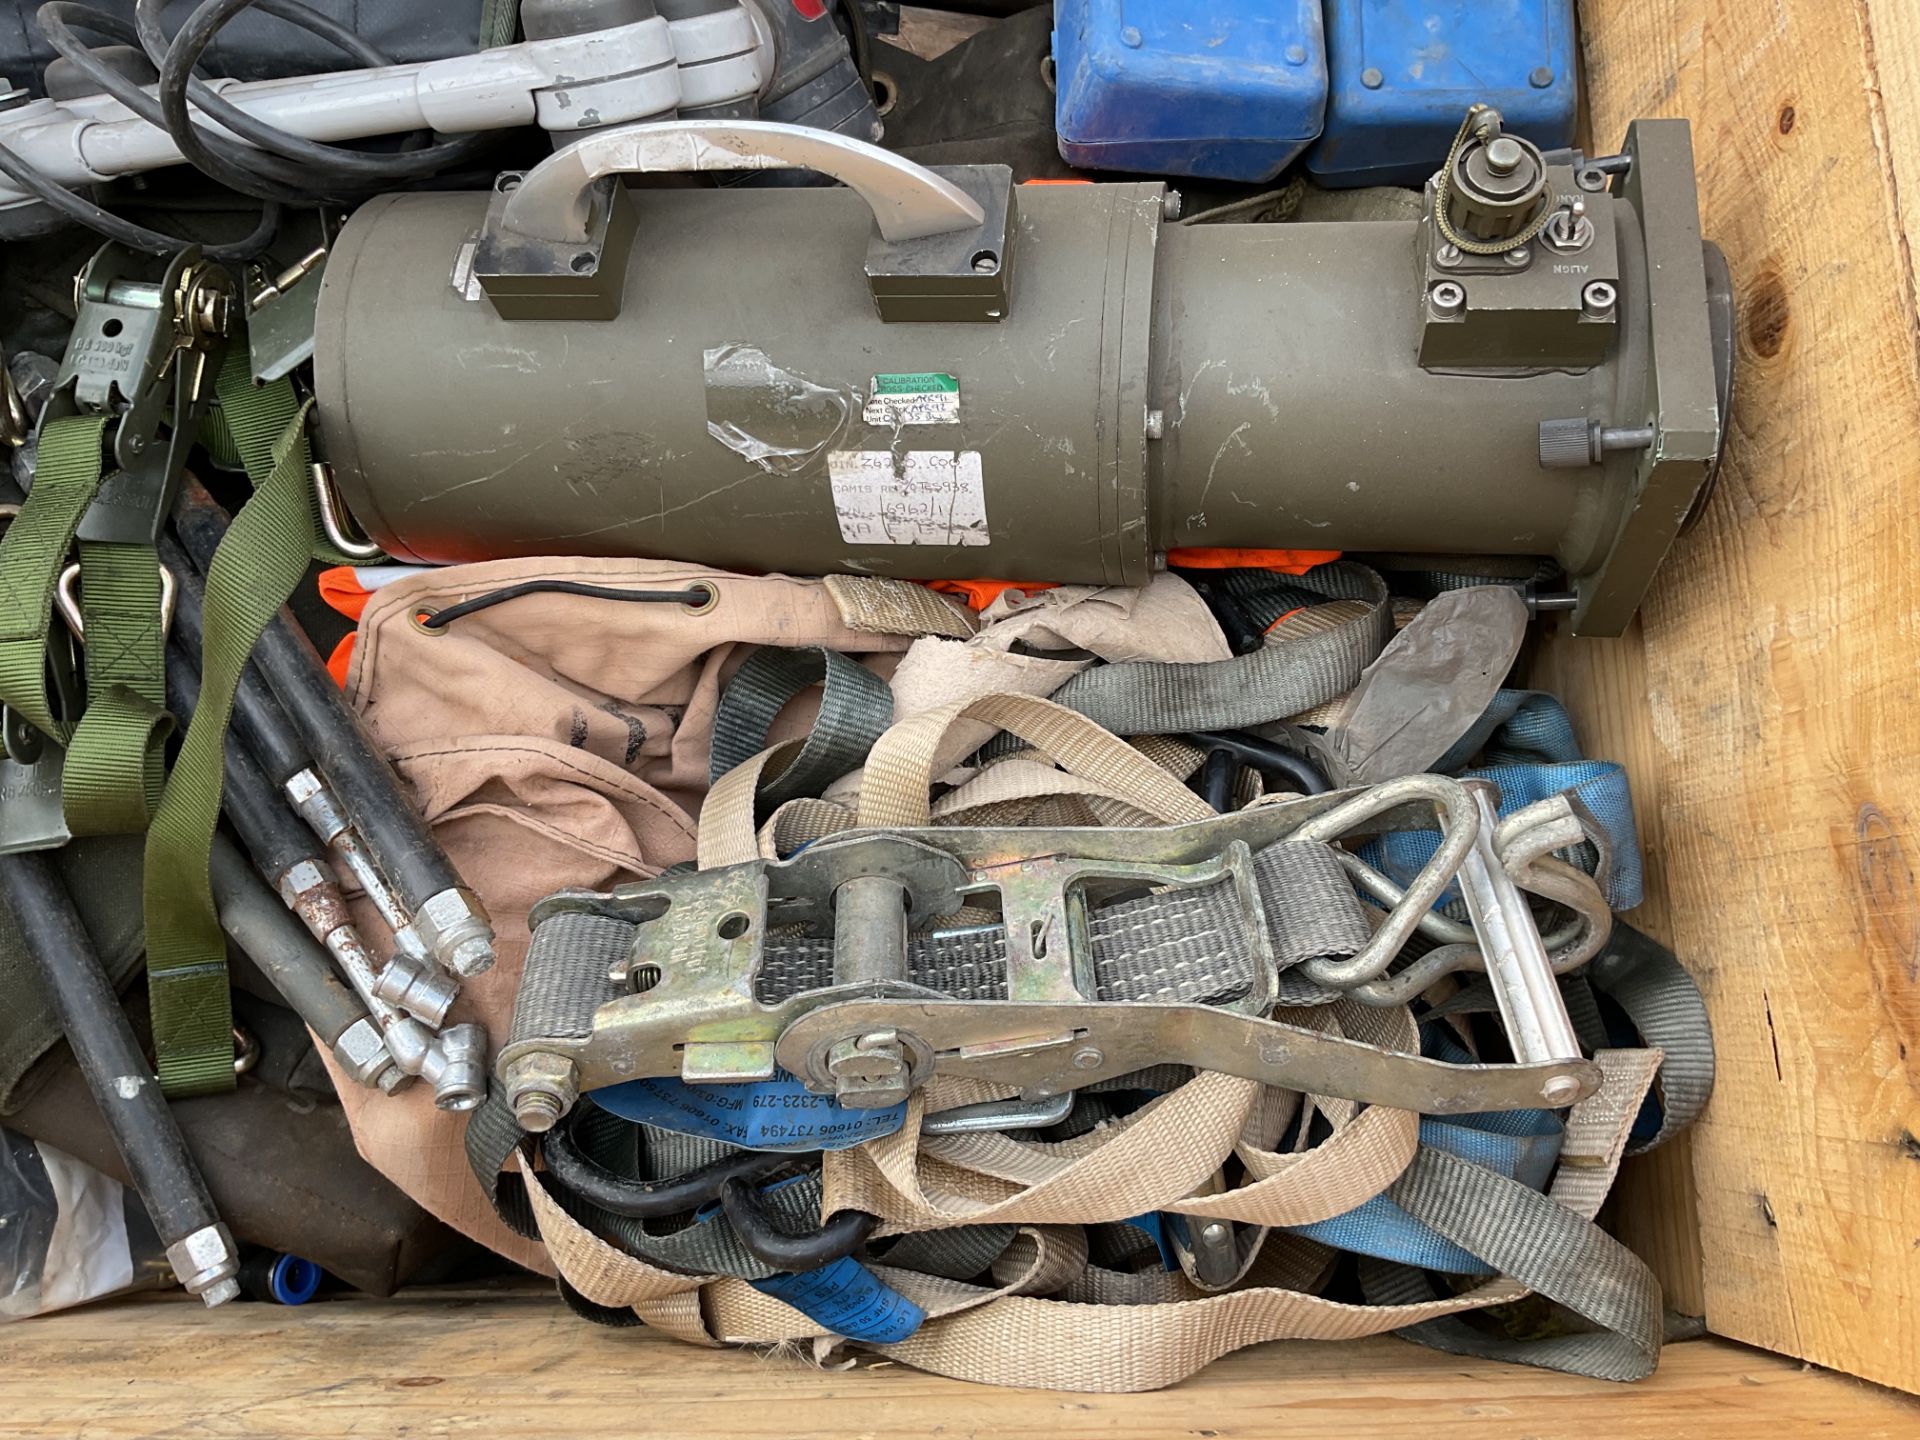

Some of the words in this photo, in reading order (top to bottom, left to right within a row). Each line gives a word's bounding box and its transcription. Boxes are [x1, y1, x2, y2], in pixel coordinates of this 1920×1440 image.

[1553, 264, 1589, 274] ALIGN
[882, 376, 935, 384] CALIBRATION
[866, 415, 881, 423] Unit
[833, 485, 873, 494] CAMIS
[753, 1094, 843, 1109] A-2323-279
[680, 1103, 720, 1127] 01606
[866, 1112, 900, 1126] TEL:
[724, 1122, 749, 1139] FAX:
[760, 1124, 815, 1138] 737494
[820, 1120, 863, 1134] 01606
[815, 1281, 840, 1299] PES
[874, 1297, 890, 1318] SHF
[897, 1309, 911, 1325] LC
